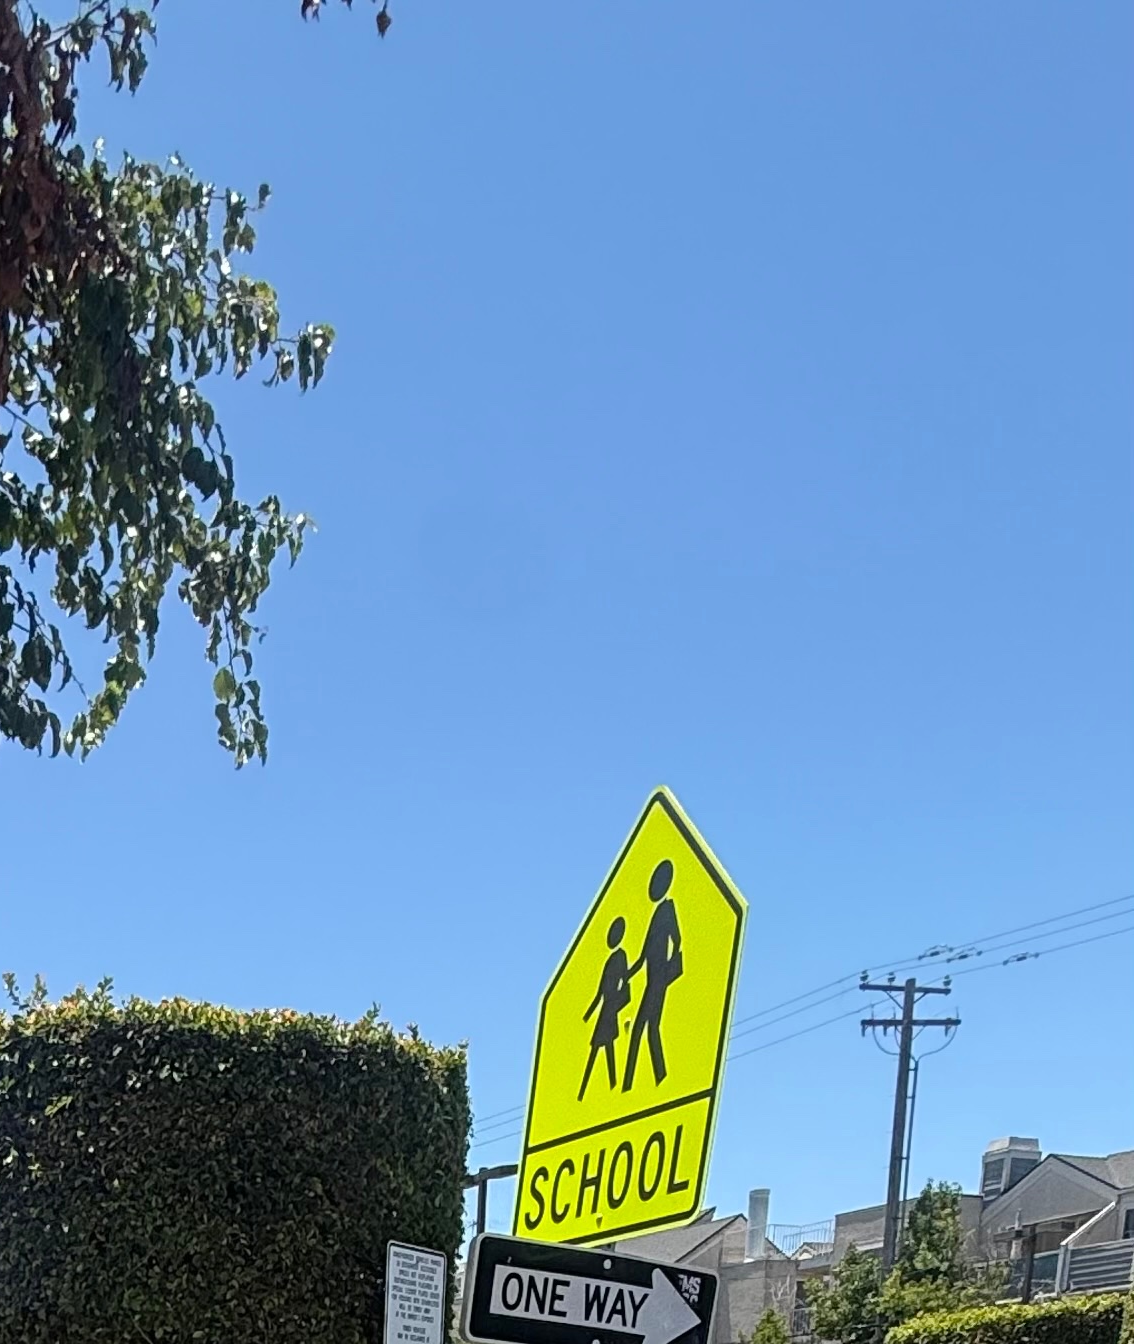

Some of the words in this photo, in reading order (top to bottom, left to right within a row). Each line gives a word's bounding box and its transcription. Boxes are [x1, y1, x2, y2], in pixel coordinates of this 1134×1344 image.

[524, 1124, 690, 1231] SCHOOL
[501, 1272, 571, 1318] ONE
[584, 1283, 650, 1329] WAY
